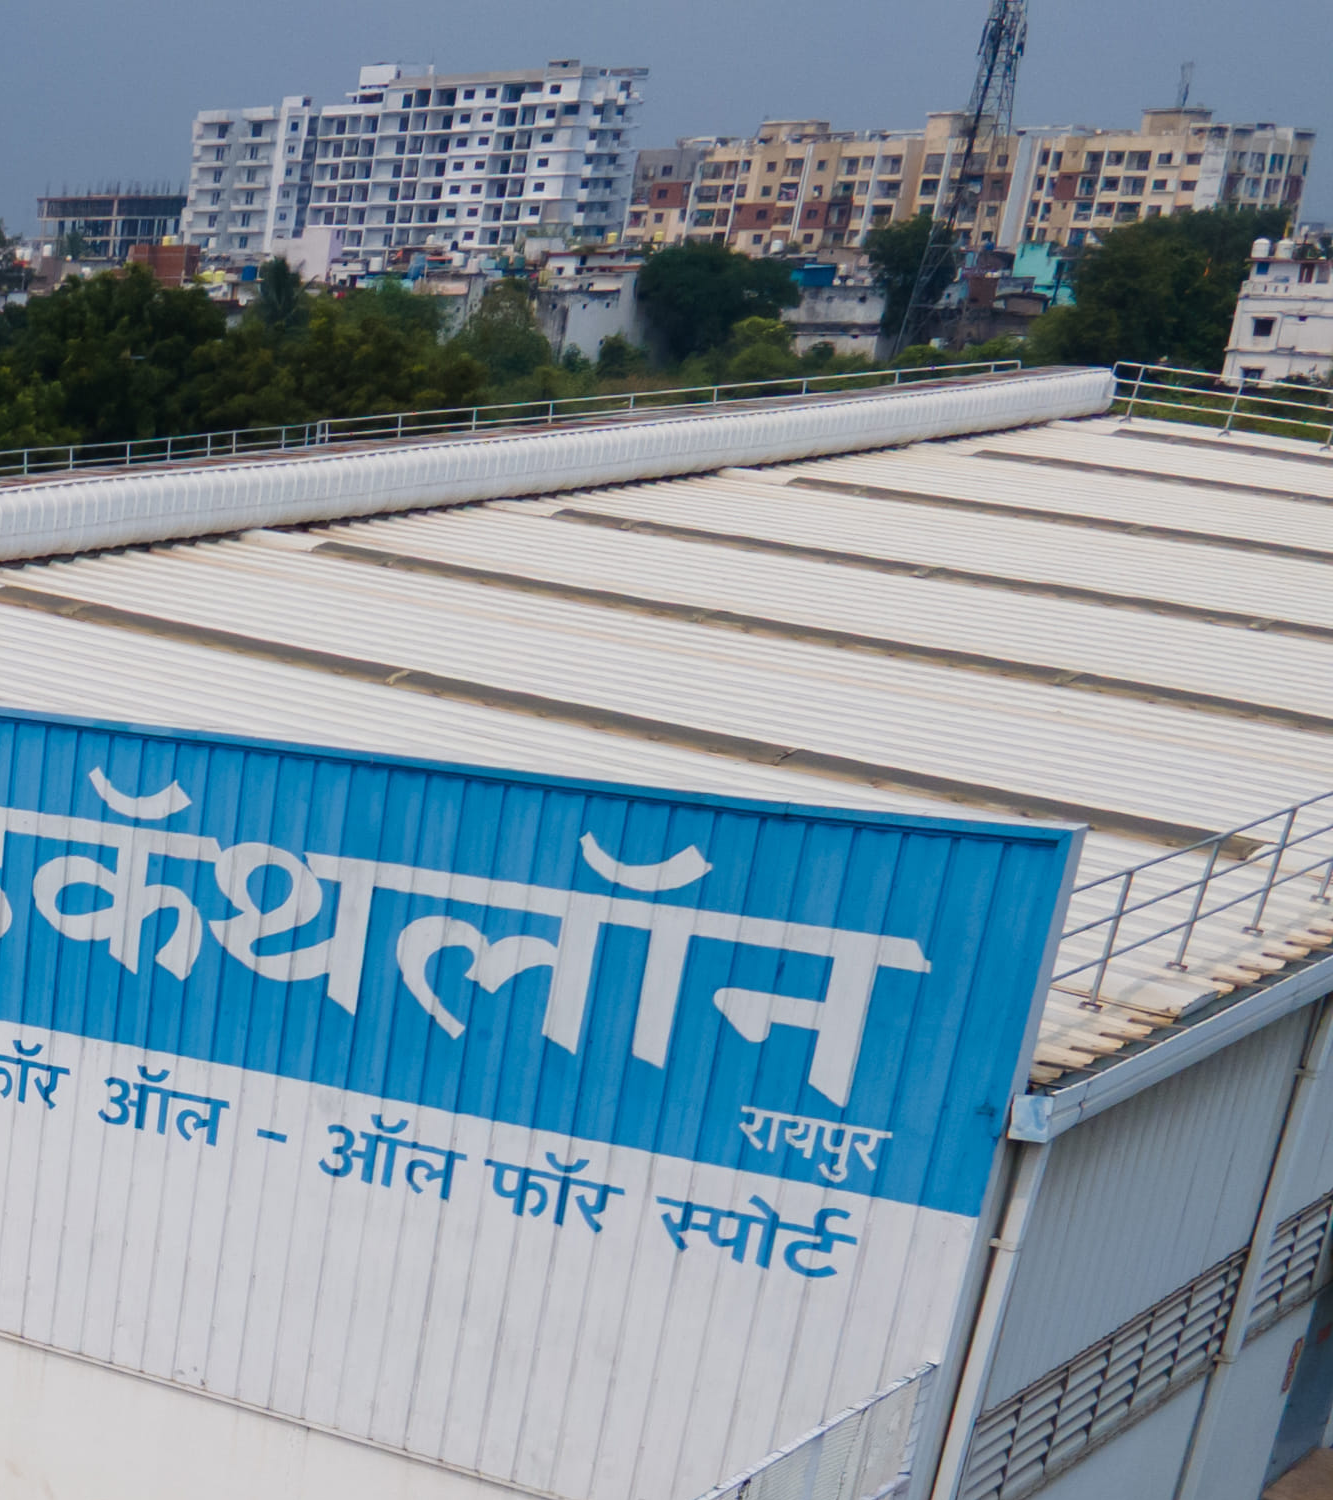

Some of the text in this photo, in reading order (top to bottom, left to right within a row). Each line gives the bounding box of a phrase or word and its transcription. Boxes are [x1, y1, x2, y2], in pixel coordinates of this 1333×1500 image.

[97, 1065, 230, 1147] ऑल
[257, 1128, 288, 1143] -
[318, 1113, 467, 1201] ऑल
[484, 1151, 625, 1234] फॉर
[656, 1195, 858, 1279] स्पोर्ट
[739, 1105, 893, 1183] रायपुर
